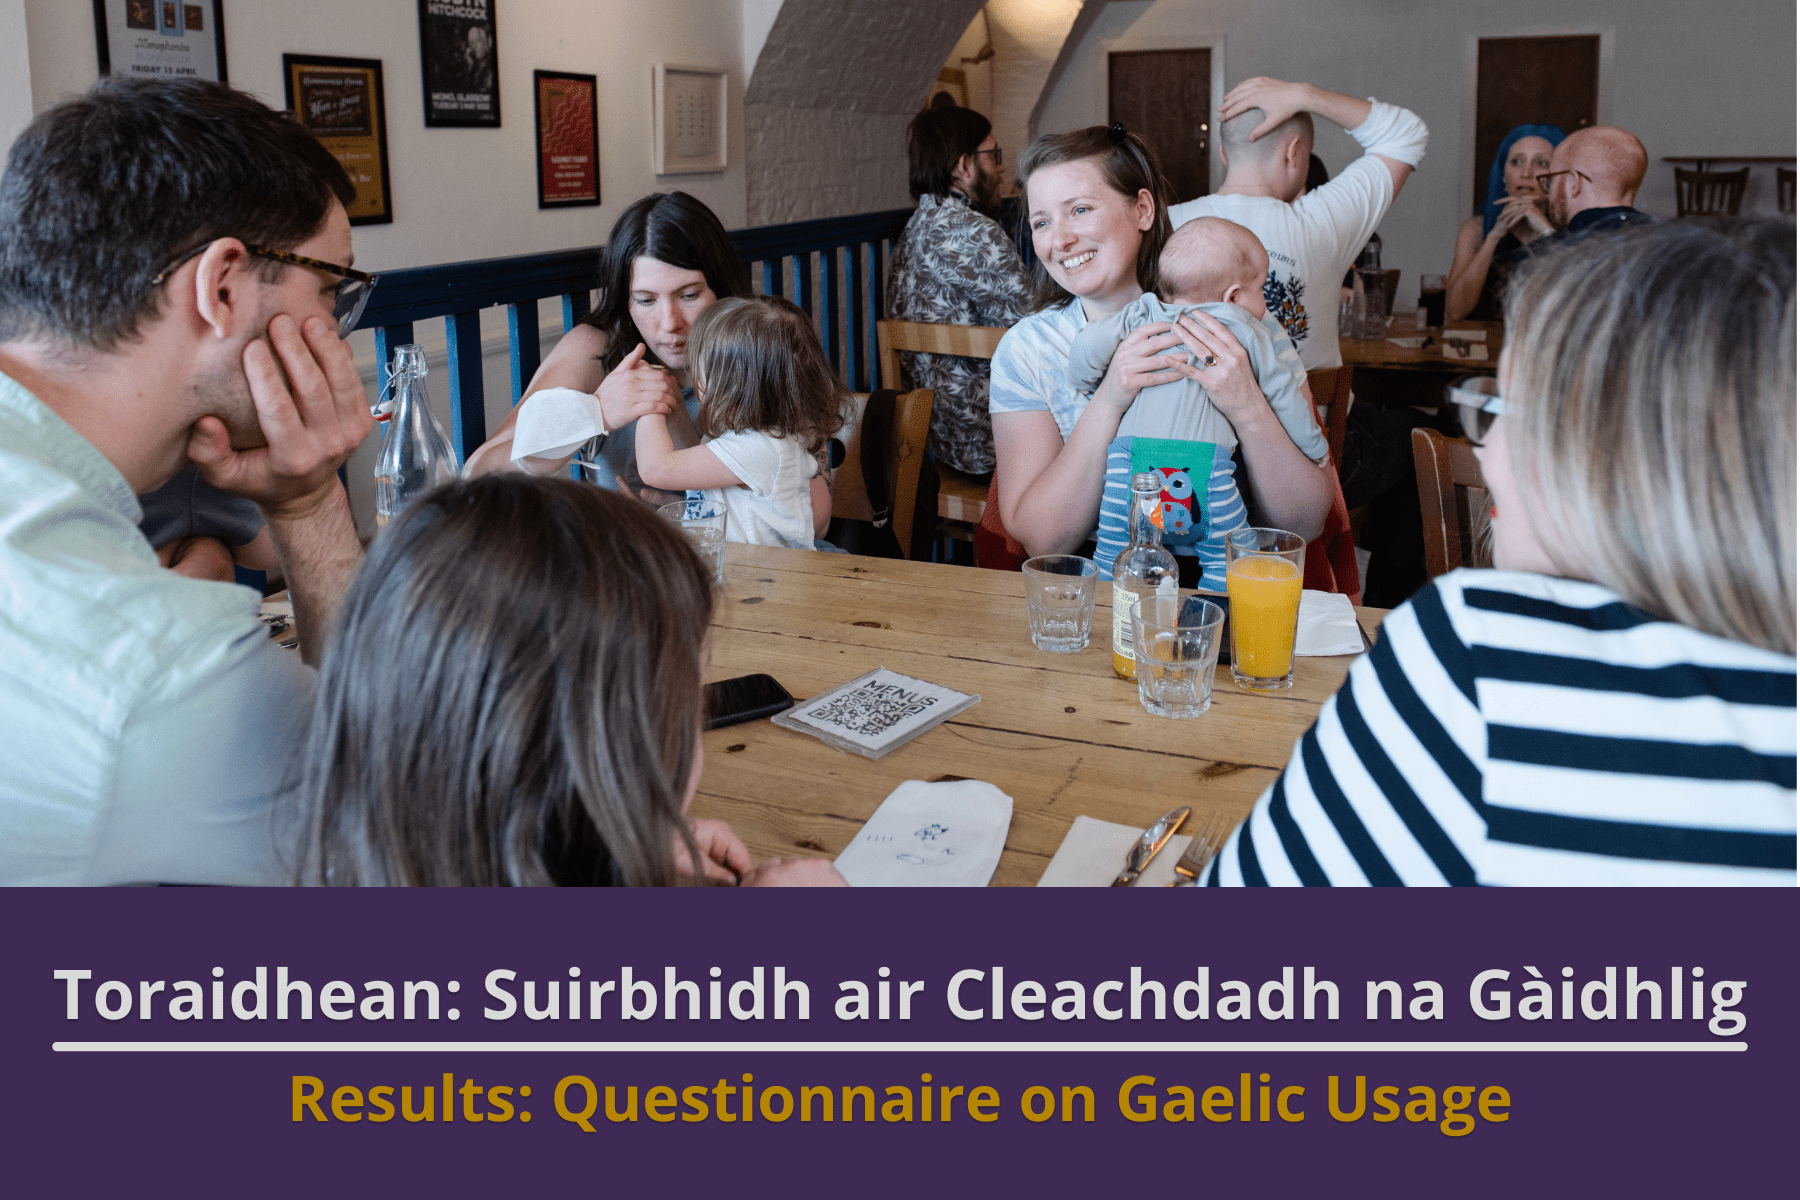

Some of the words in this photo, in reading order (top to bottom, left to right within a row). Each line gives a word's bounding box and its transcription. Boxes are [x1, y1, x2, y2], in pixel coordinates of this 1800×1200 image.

[428, 3, 487, 20] HITCHCOCK
[131, 64, 160, 74] FRIDAY
[175, 66, 197, 75] APRIL
[863, 680, 939, 706] MENUS
